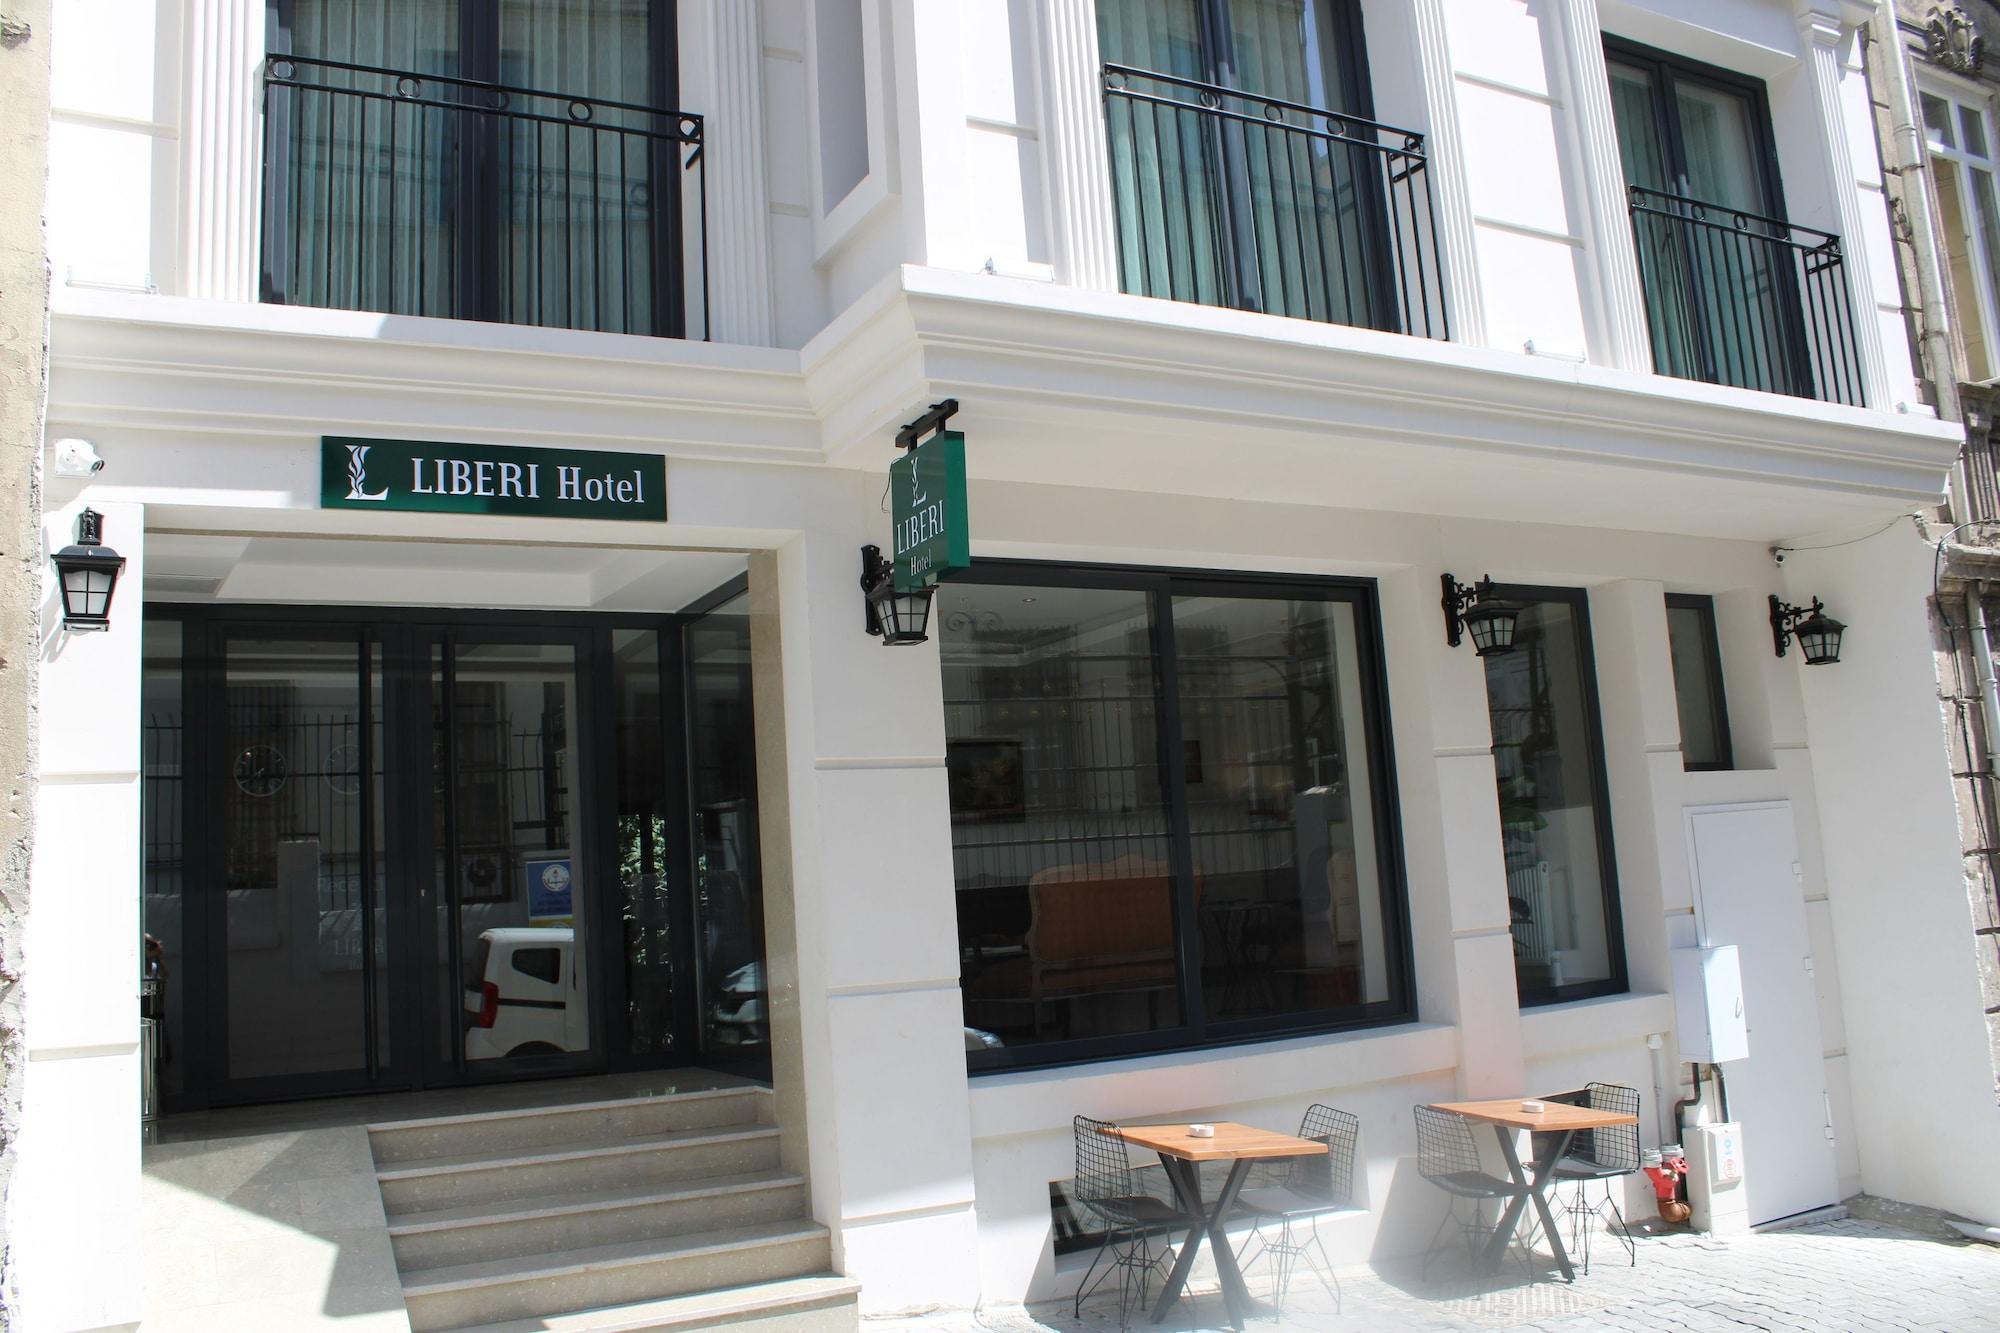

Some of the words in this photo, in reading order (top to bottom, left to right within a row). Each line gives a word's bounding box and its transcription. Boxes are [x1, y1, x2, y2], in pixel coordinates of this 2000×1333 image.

[410, 457, 540, 498] LIBERI
[556, 465, 645, 503] Hotel
[897, 500, 944, 555] LIBERI
[910, 548, 932, 577] Hotel
